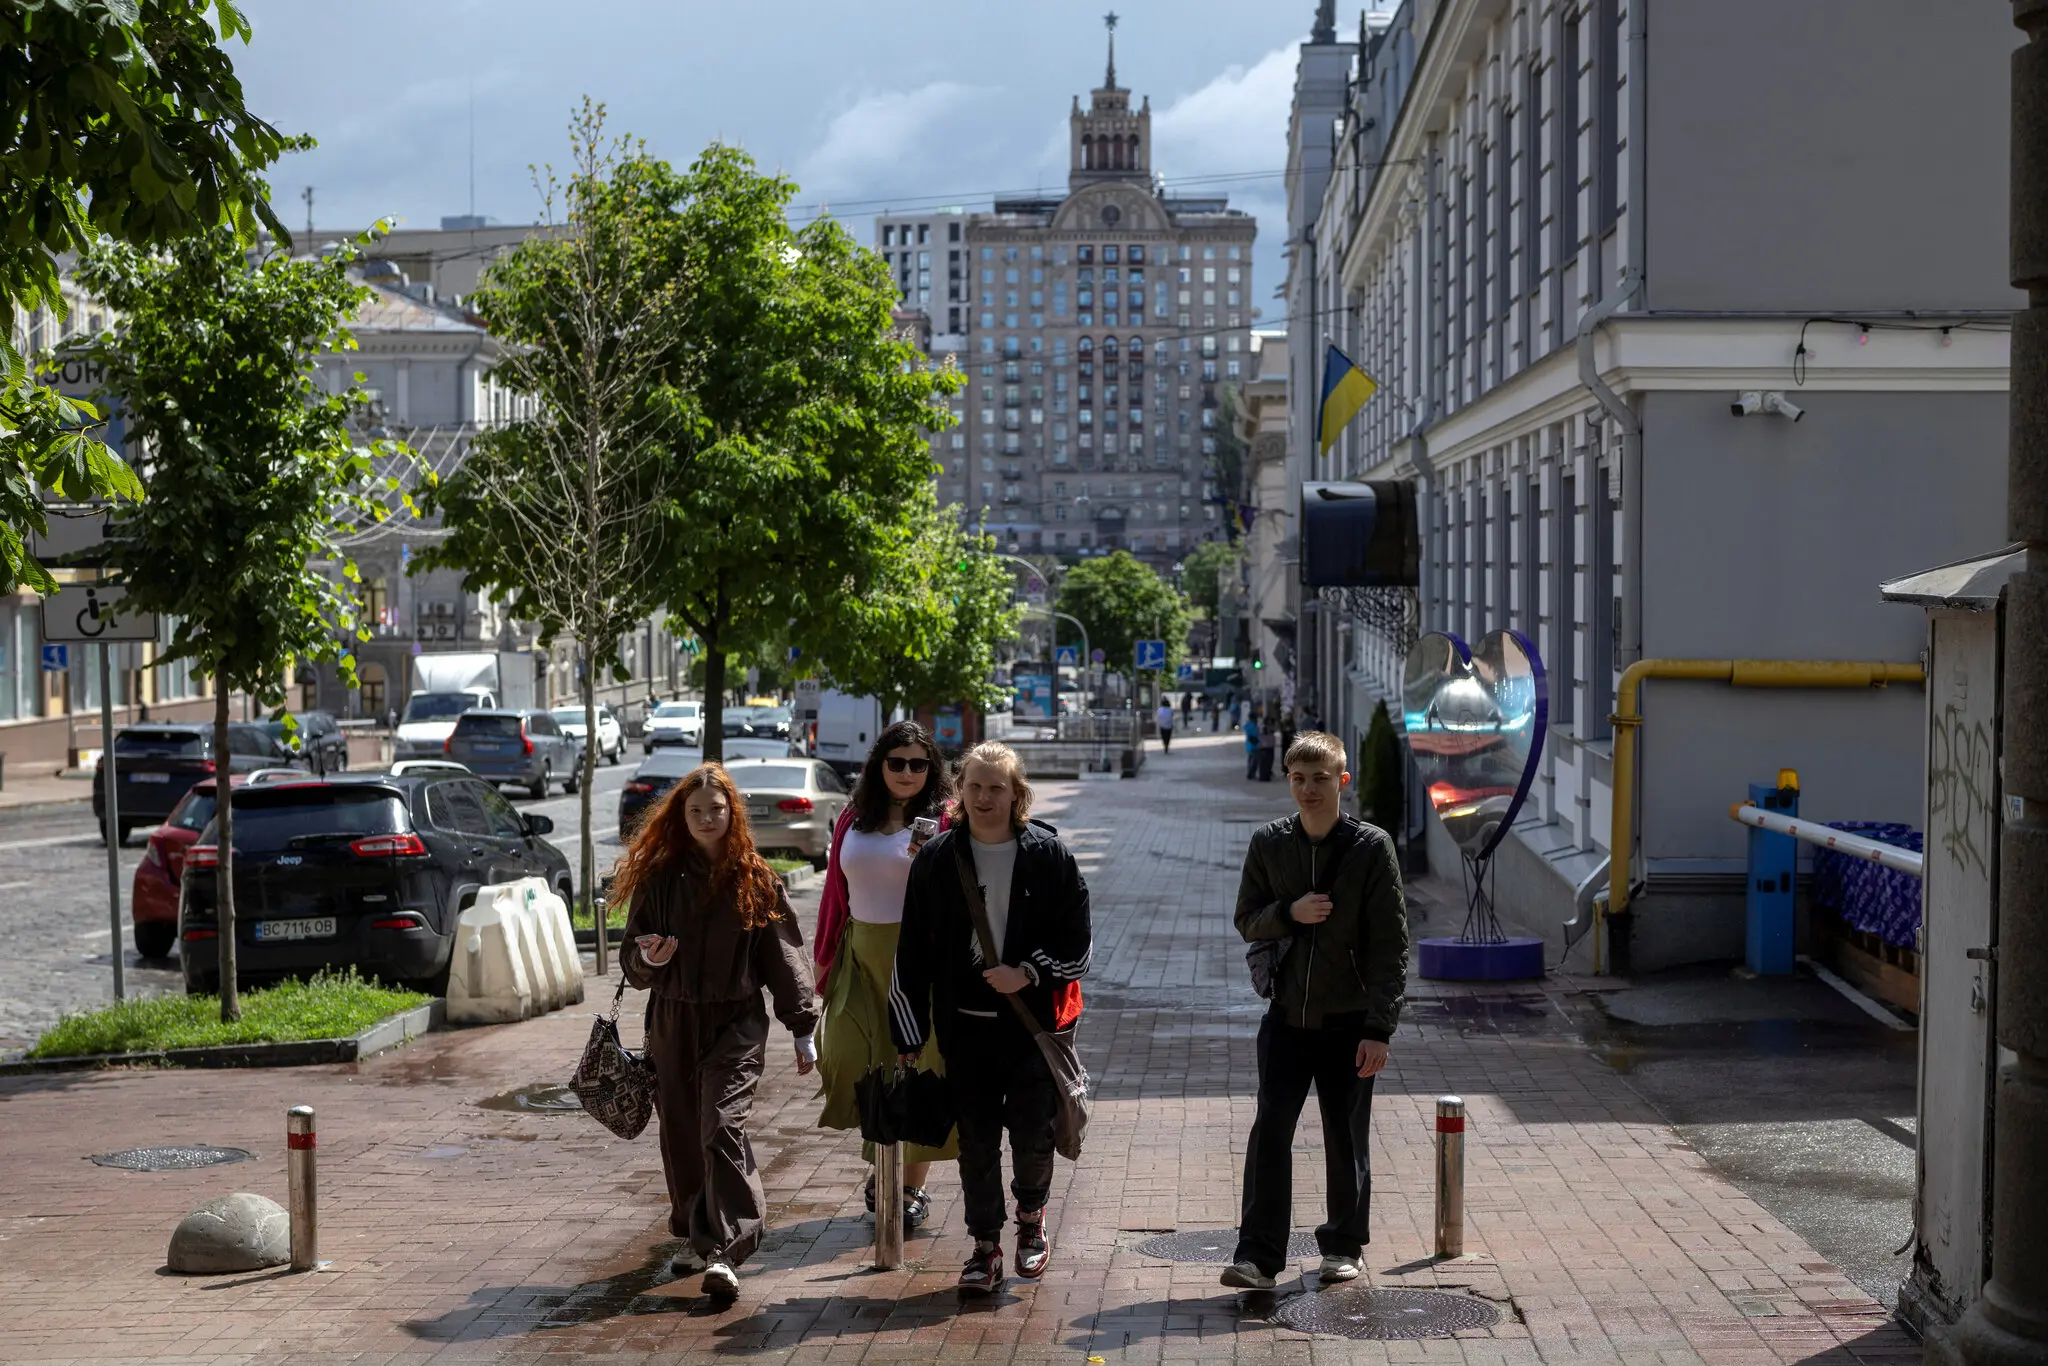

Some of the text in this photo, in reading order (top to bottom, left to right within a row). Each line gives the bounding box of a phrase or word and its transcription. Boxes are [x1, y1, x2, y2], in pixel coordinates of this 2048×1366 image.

[277, 855, 303, 866] Jeep
[263, 920, 333, 936] BC 7116 OB
